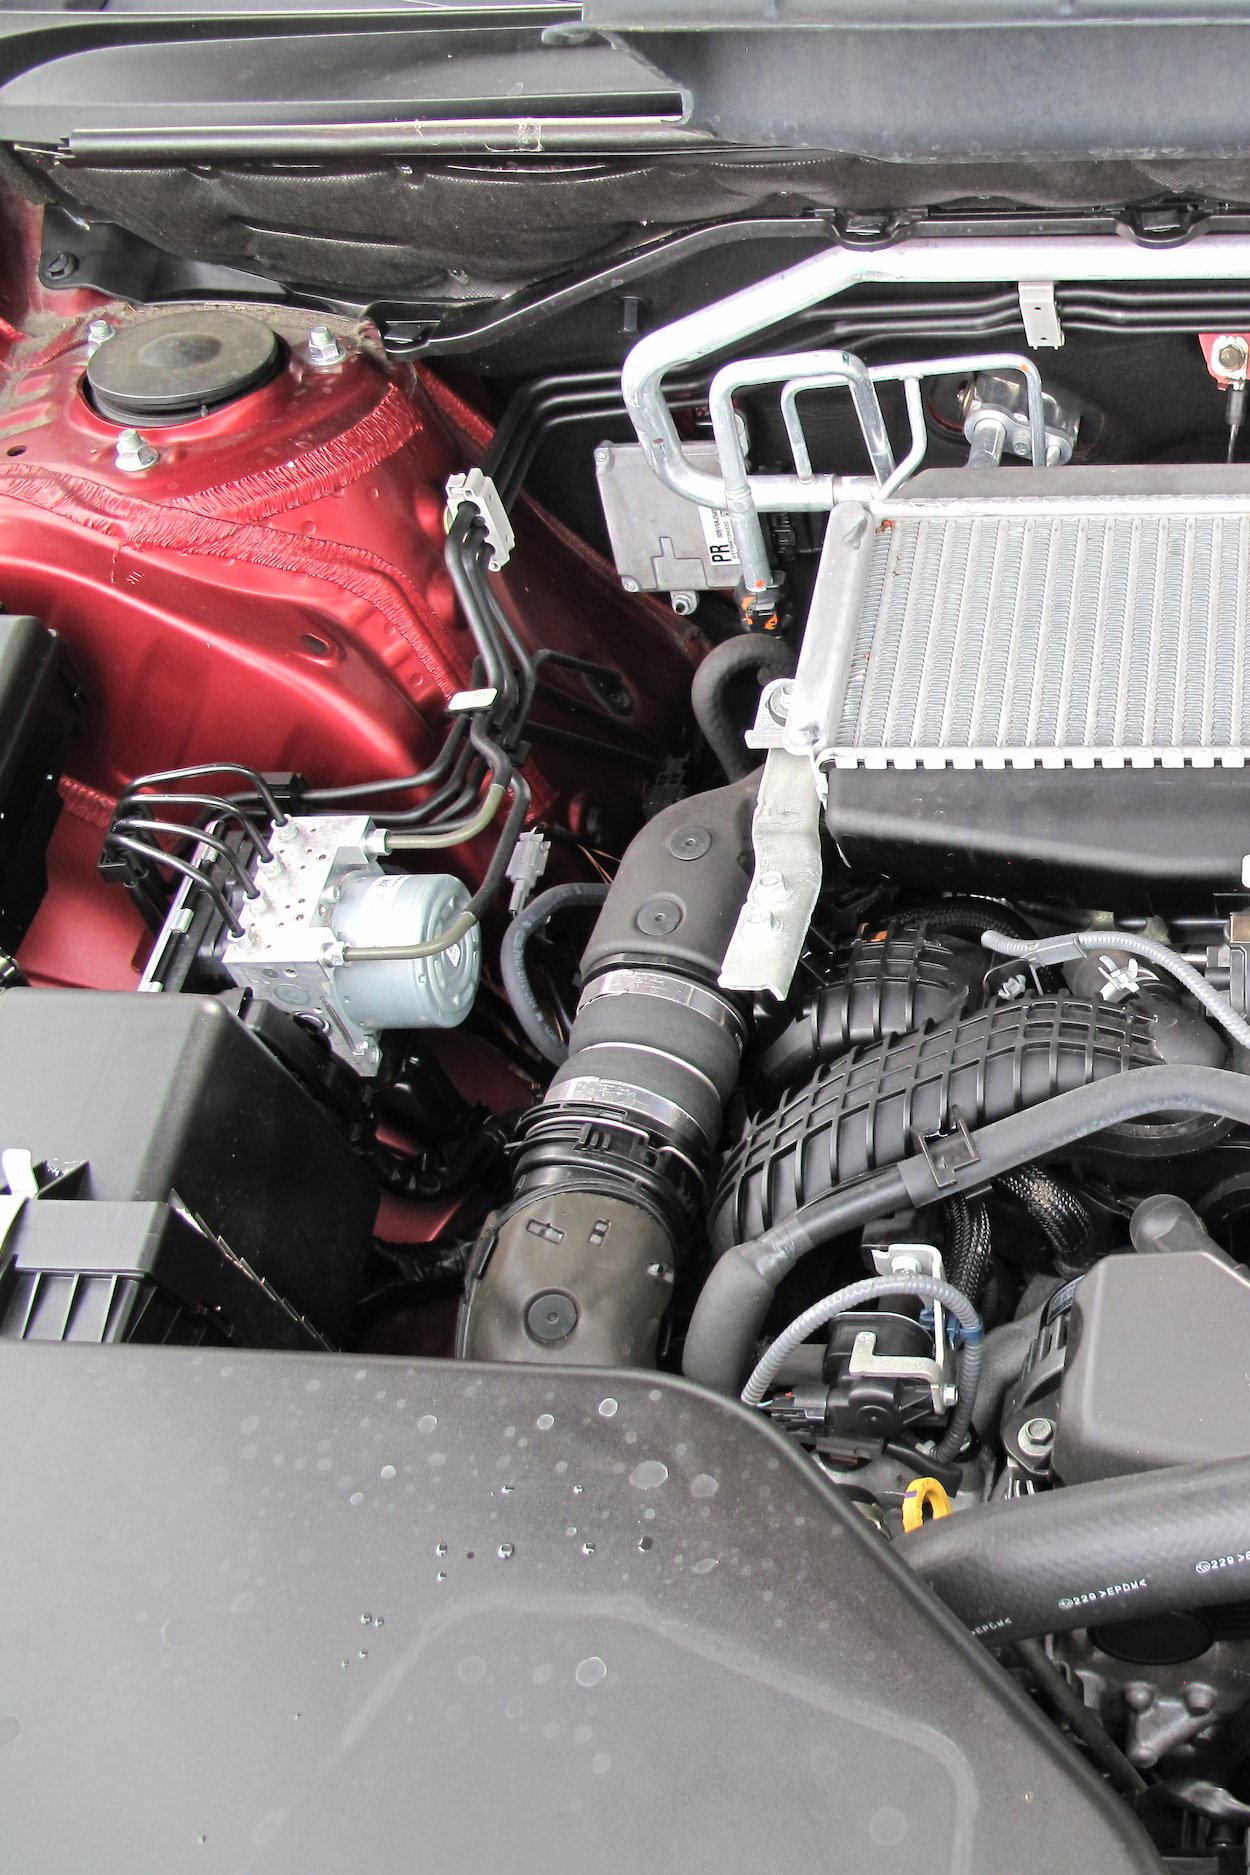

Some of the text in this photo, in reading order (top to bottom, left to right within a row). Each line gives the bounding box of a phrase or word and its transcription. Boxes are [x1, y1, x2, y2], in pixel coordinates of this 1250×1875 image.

[709, 544, 732, 563] PR
[1210, 1555, 1235, 1570] 229
[1072, 1592, 1097, 1606] 229
